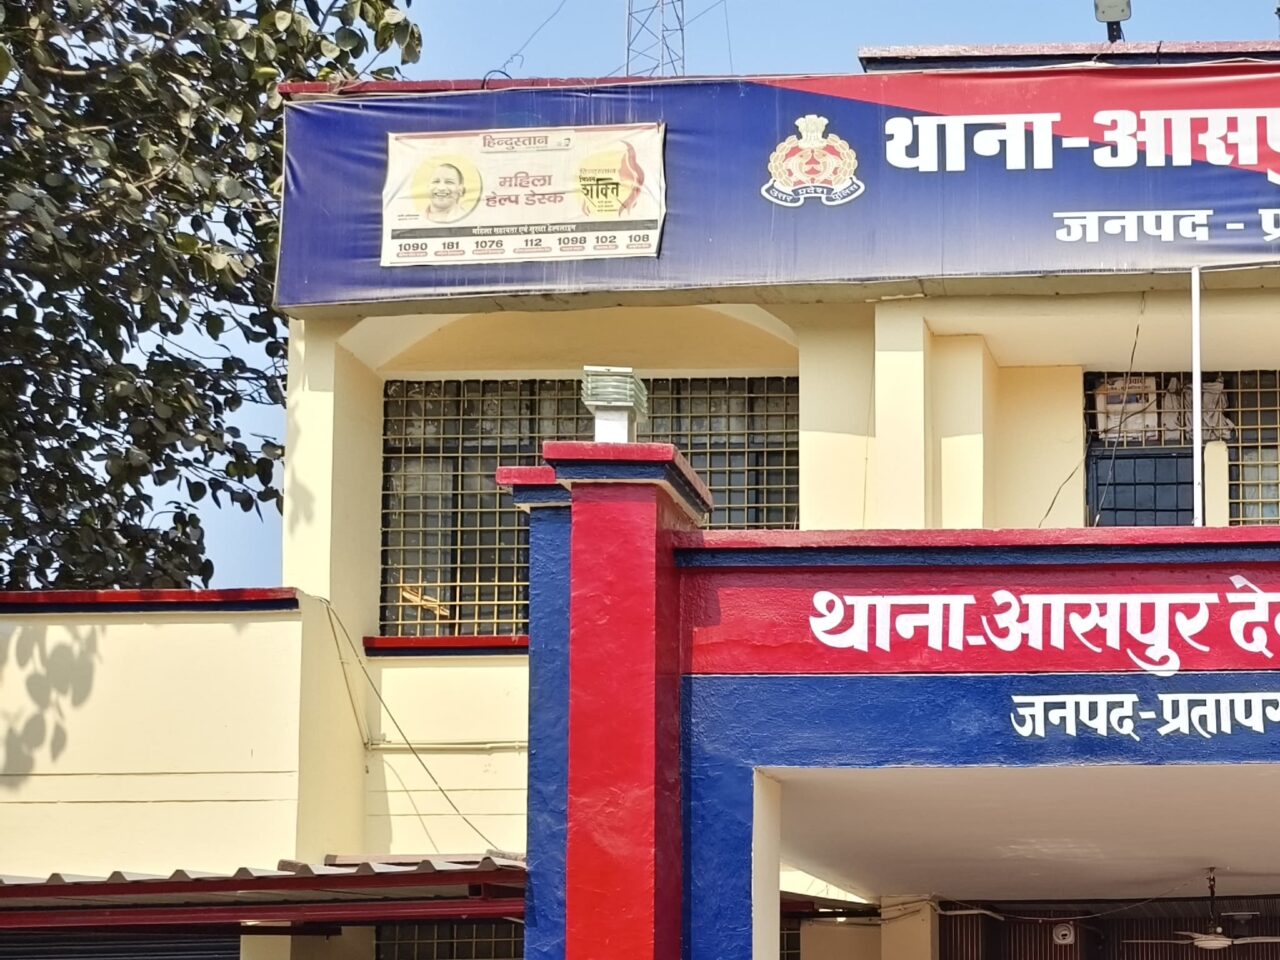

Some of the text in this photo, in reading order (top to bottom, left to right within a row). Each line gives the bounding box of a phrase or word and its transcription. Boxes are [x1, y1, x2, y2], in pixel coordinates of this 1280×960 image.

[483, 134, 549, 150] हिन्दुस्तान
[499, 171, 553, 188] महिला
[485, 190, 566, 207] हेल्प डेस्क
[1053, 208, 1214, 244] जनपद
[398, 234, 649, 252] 1090 181 1076 112 1098 102 108
